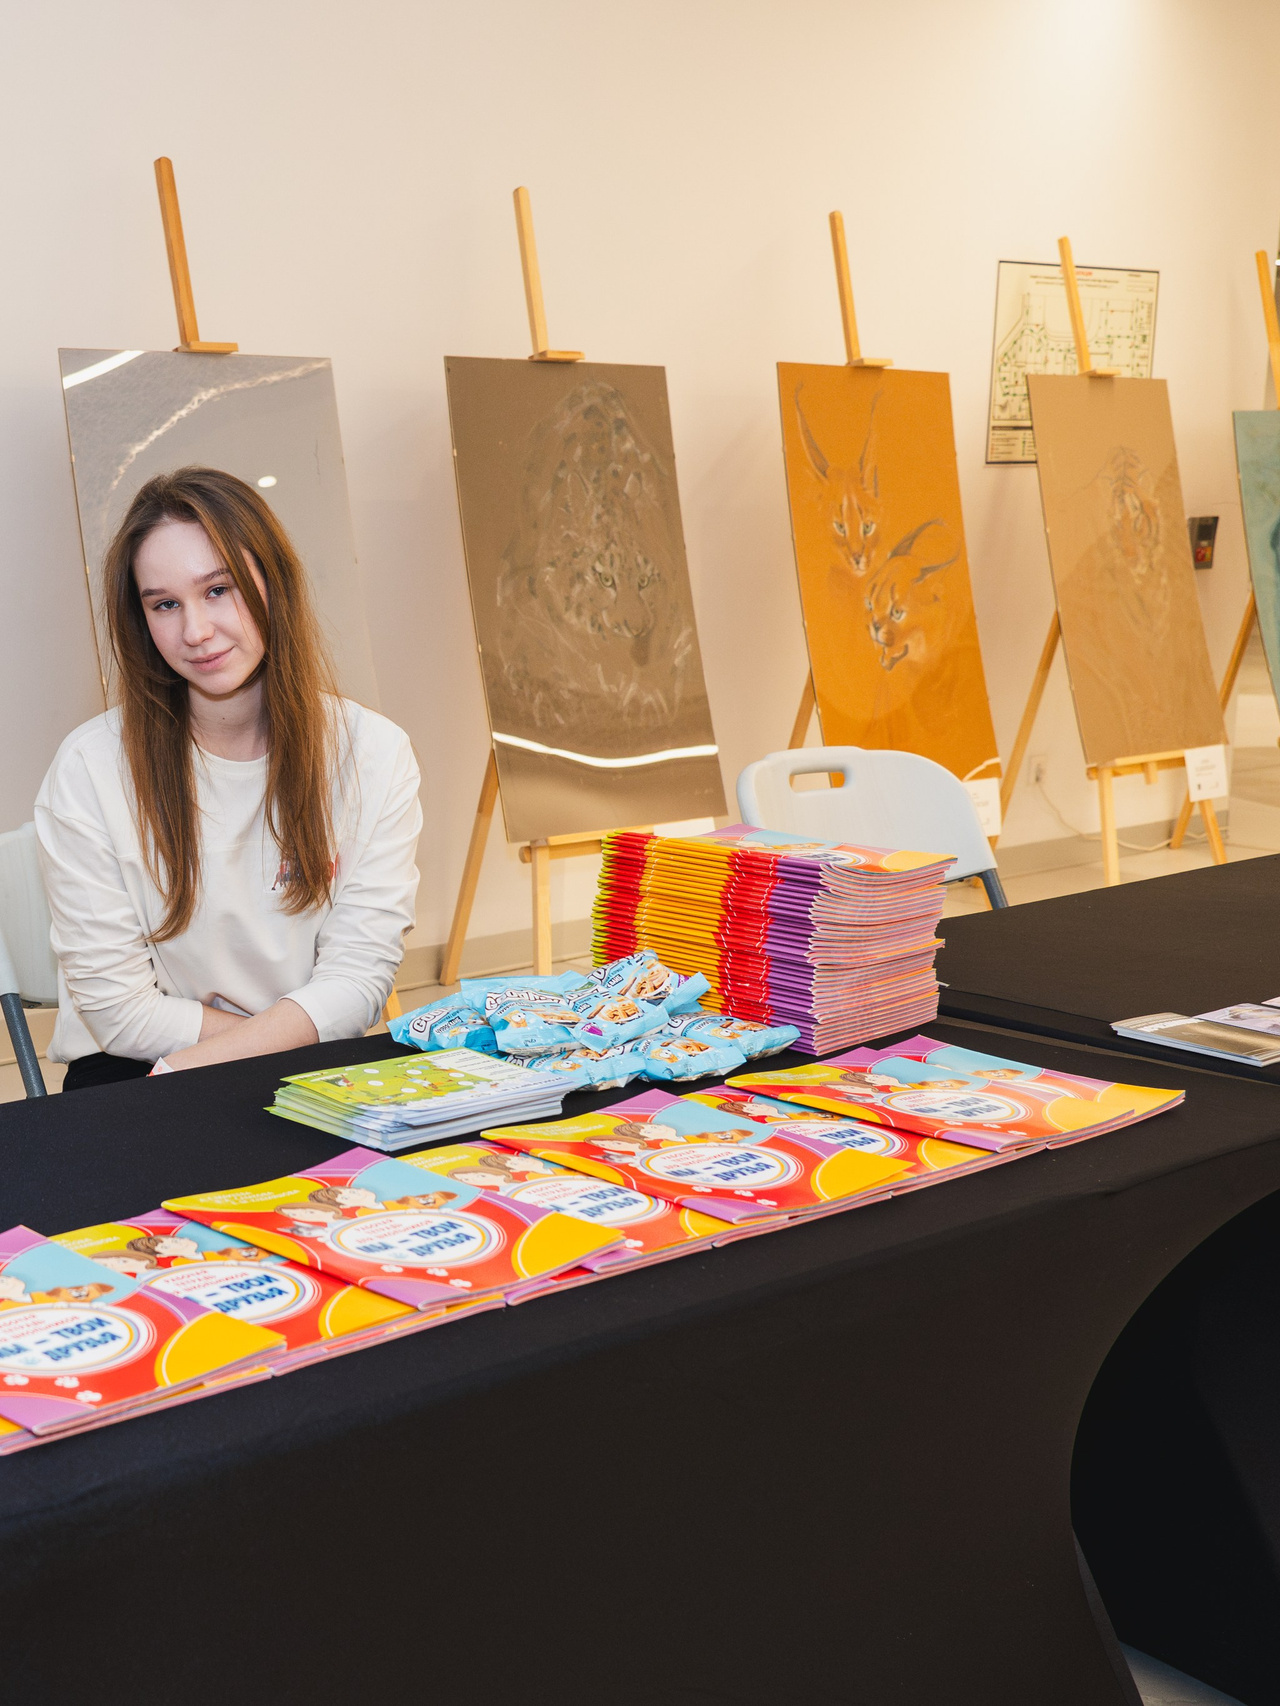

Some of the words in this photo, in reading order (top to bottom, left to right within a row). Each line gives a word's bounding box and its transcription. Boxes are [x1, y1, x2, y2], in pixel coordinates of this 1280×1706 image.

[665, 1167, 701, 1178] МЫ
[712, 1152, 762, 1167] ТВОИ
[712, 1162, 776, 1182] ДРУЗЬЯ
[578, 1186, 631, 1201] ТВОИ
[578, 1196, 645, 1218] ДРУЗЬЯ
[356, 1241, 396, 1254] МЫ
[409, 1220, 464, 1239] ТВОИ
[407, 1232, 477, 1257] ДРУЗЬЯ
[220, 1274, 280, 1293] ТВОИ
[212, 1287, 289, 1314] ДРУЗЬЯ
[49, 1317, 112, 1339] ТВОИ
[42, 1331, 123, 1361] ДРУЗЬЯ
